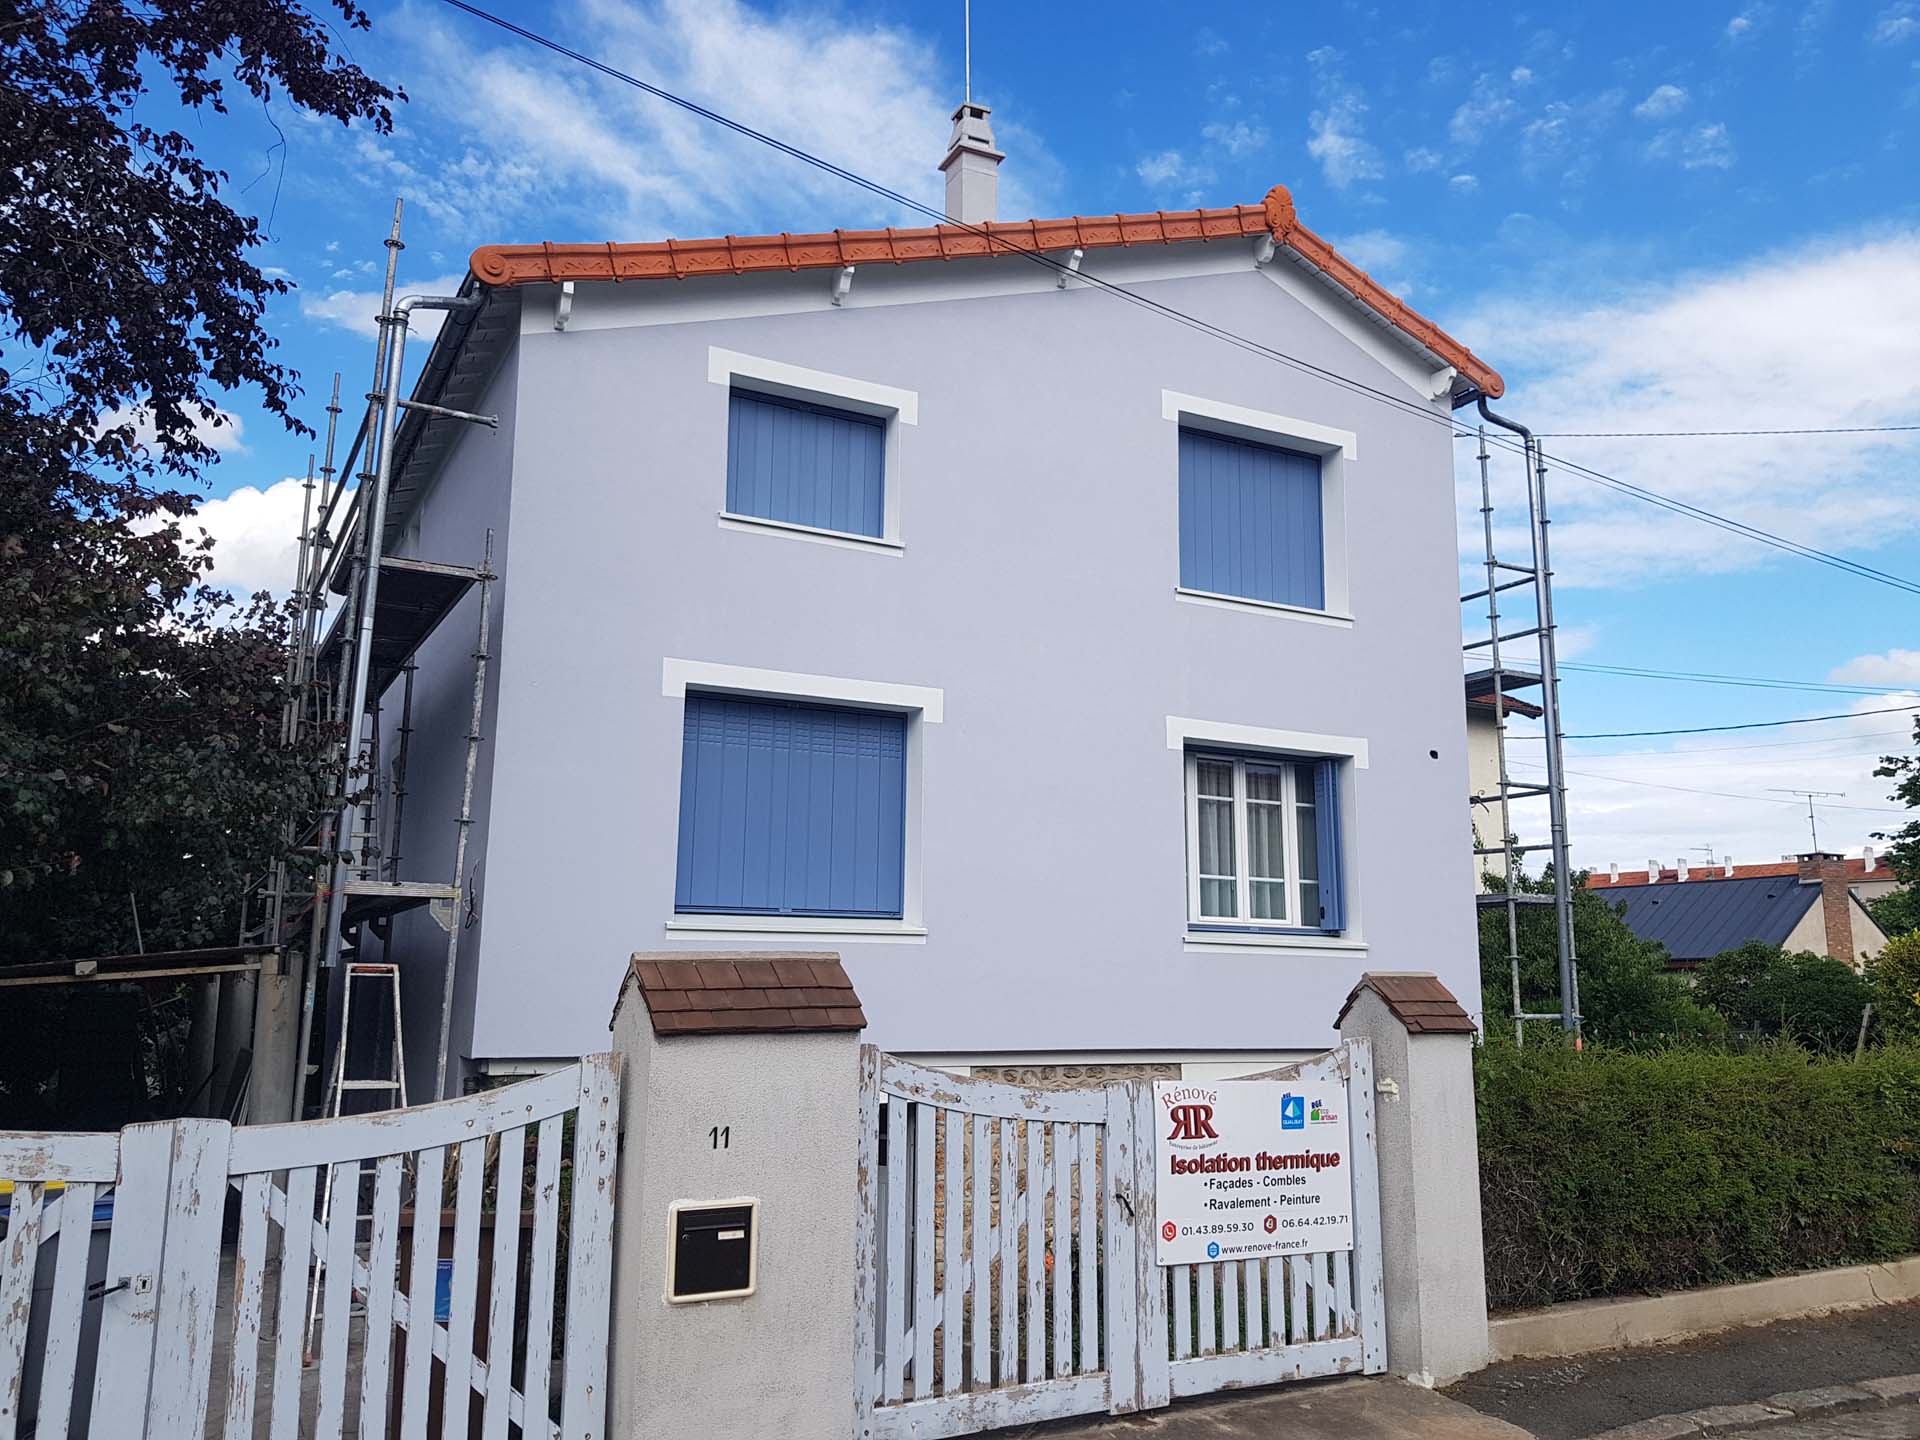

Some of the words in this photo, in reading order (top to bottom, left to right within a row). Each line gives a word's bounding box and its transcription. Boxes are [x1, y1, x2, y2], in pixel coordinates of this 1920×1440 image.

[1161, 1086, 1217, 1110] Rénové
[708, 1125, 730, 1150] 11
[1171, 1152, 1250, 1175] Isolation
[1255, 1150, 1341, 1173] thermique
[1209, 1177, 1254, 1192] Façades
[1263, 1174, 1307, 1187] Combles
[1209, 1196, 1271, 1210] Ravalement
[1279, 1193, 1321, 1206] Peinture
[1181, 1222, 1255, 1236] 01.43.89.59.30
[1281, 1215, 1349, 1228] 06.64.42.19.71
[1221, 1238, 1308, 1255] www.renove-france.fr
